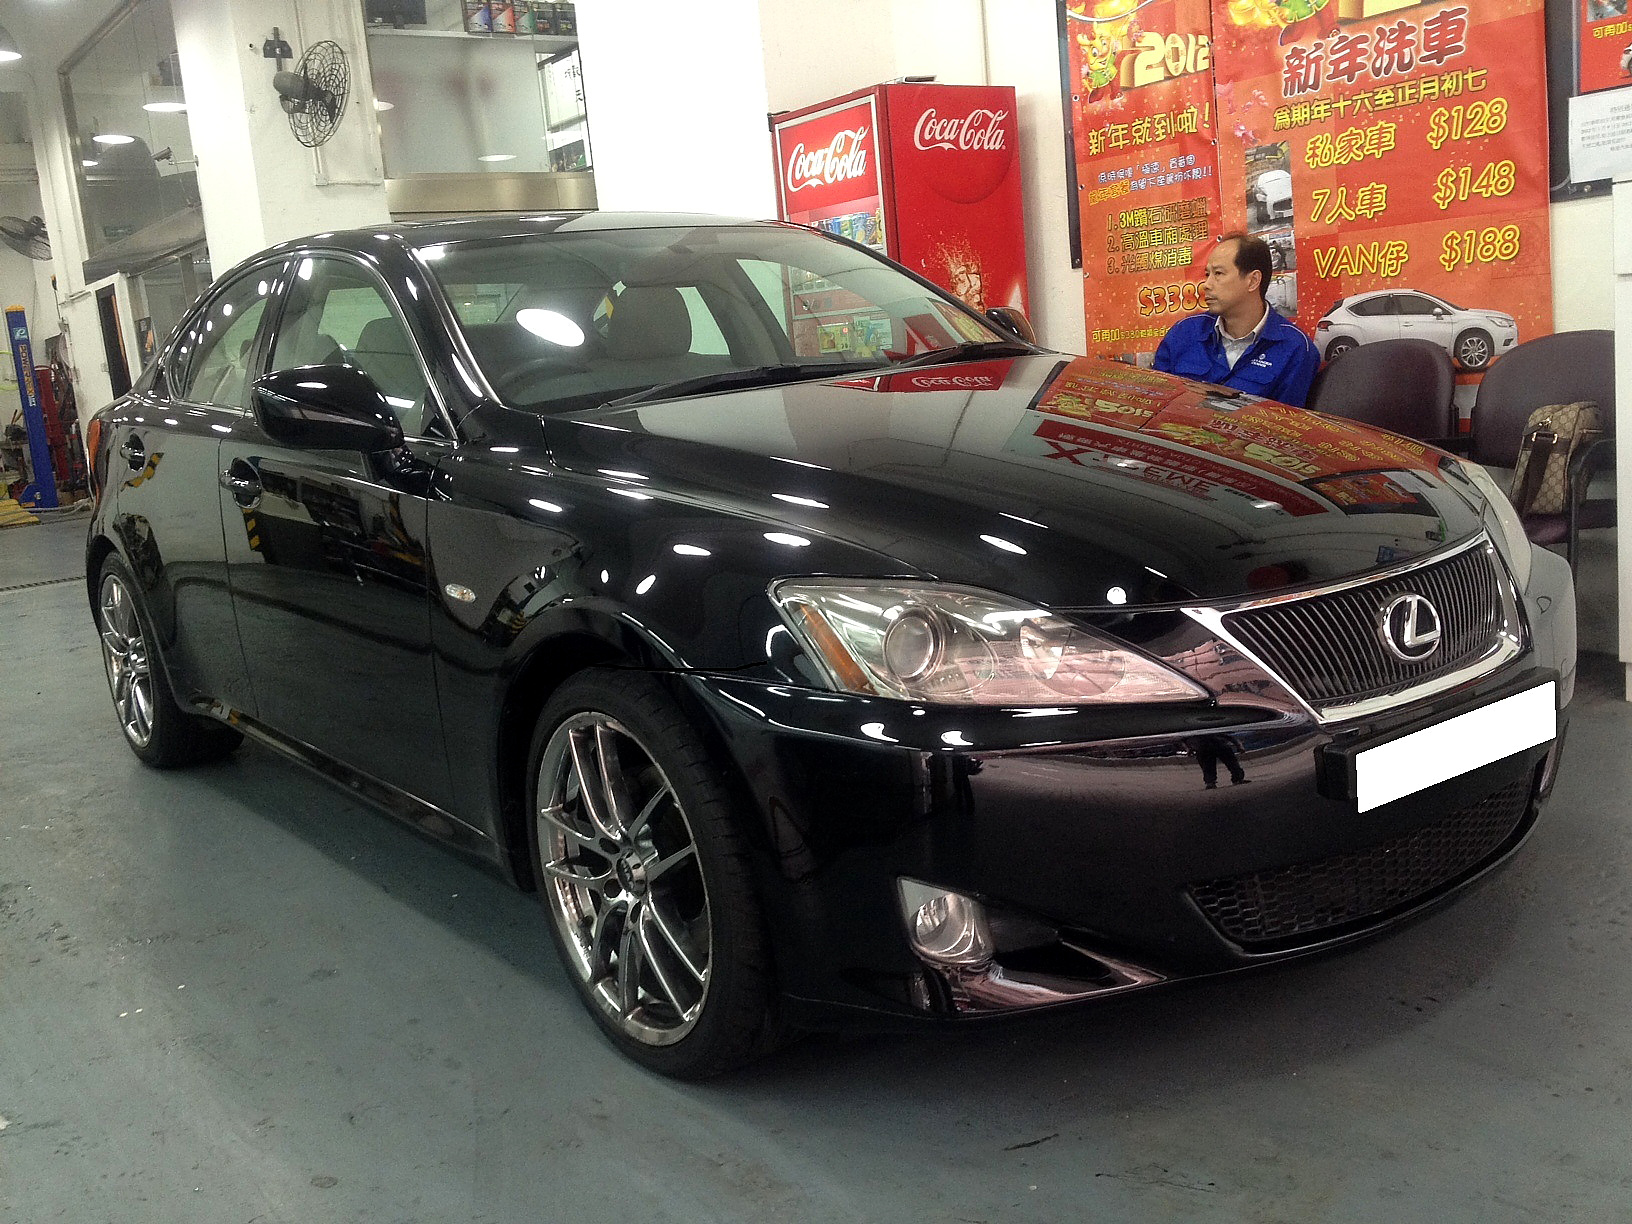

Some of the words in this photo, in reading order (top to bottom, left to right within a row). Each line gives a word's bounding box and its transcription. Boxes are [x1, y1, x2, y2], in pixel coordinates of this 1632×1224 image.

[1134, 31, 1210, 88] 2012
[1282, 7, 1469, 98] 新年洗車
[788, 126, 869, 192] Coca-Cola
[914, 108, 1009, 151] Coca-Cola
[1305, 121, 1396, 168] 私家車
[1427, 97, 1508, 149] $128
[1310, 182, 1388, 224] 7人車
[1434, 160, 1515, 208] $148
[1314, 240, 1408, 278] VAN仔
[1439, 225, 1520, 272] $188
